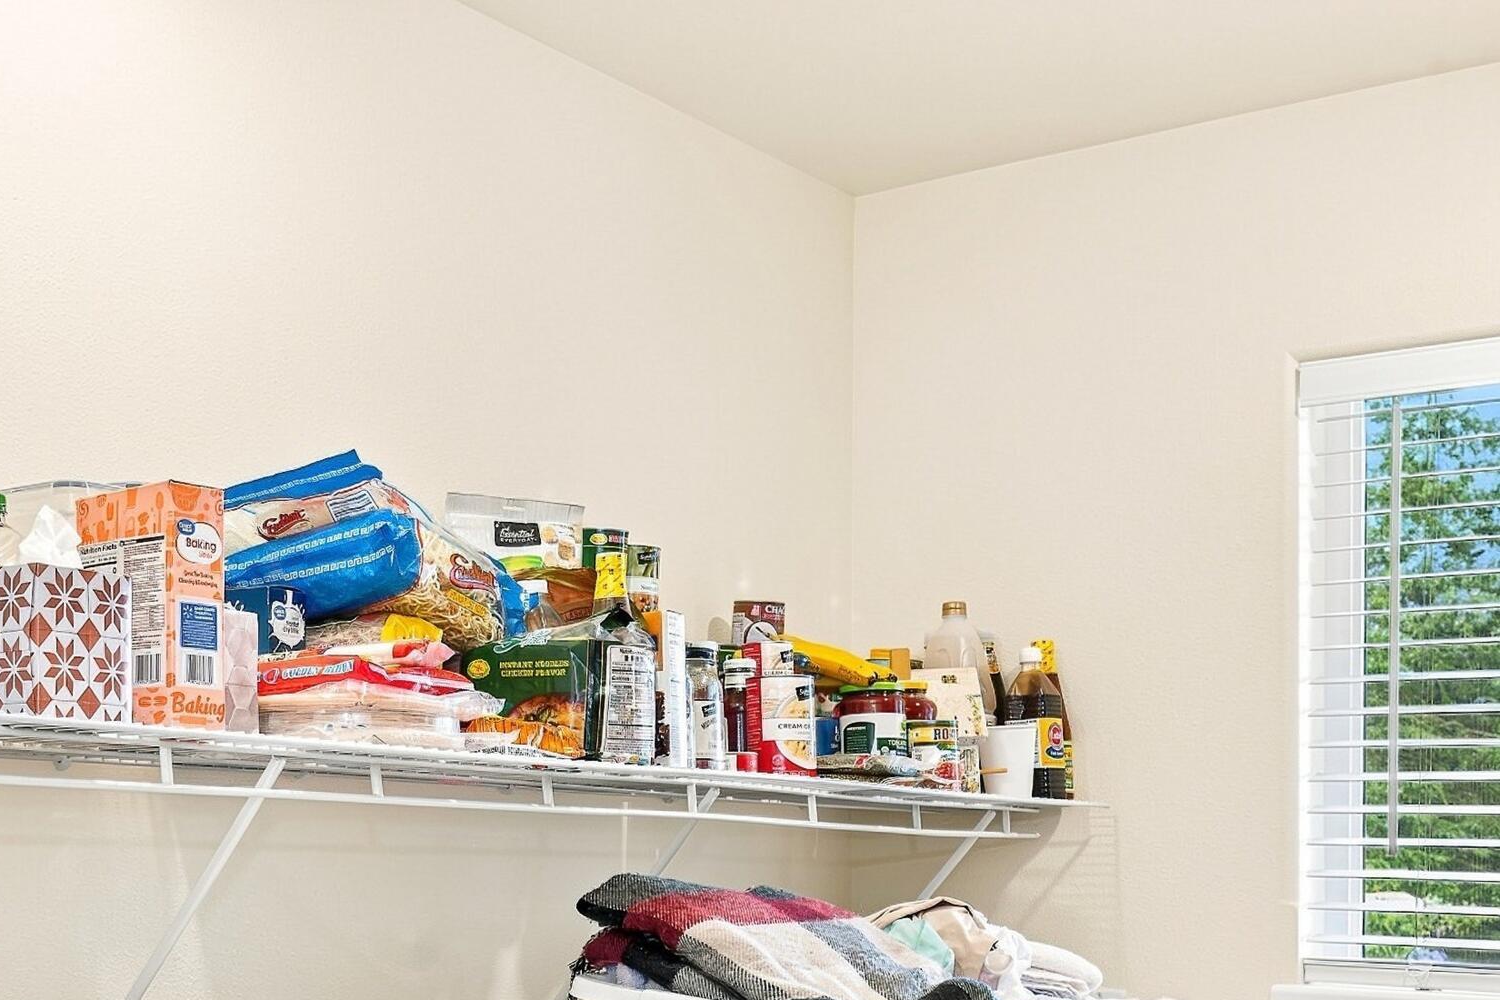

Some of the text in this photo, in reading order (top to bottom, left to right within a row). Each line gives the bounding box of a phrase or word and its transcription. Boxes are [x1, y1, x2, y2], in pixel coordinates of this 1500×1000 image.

[500, 526, 535, 538] Essential
[102, 544, 118, 552] Facts
[185, 537, 217, 553] Baking
[499, 659, 570, 669] INSTANT NOODLES
[500, 668, 567, 678] CHICKEN FLAVOR
[173, 692, 226, 723] Baking
